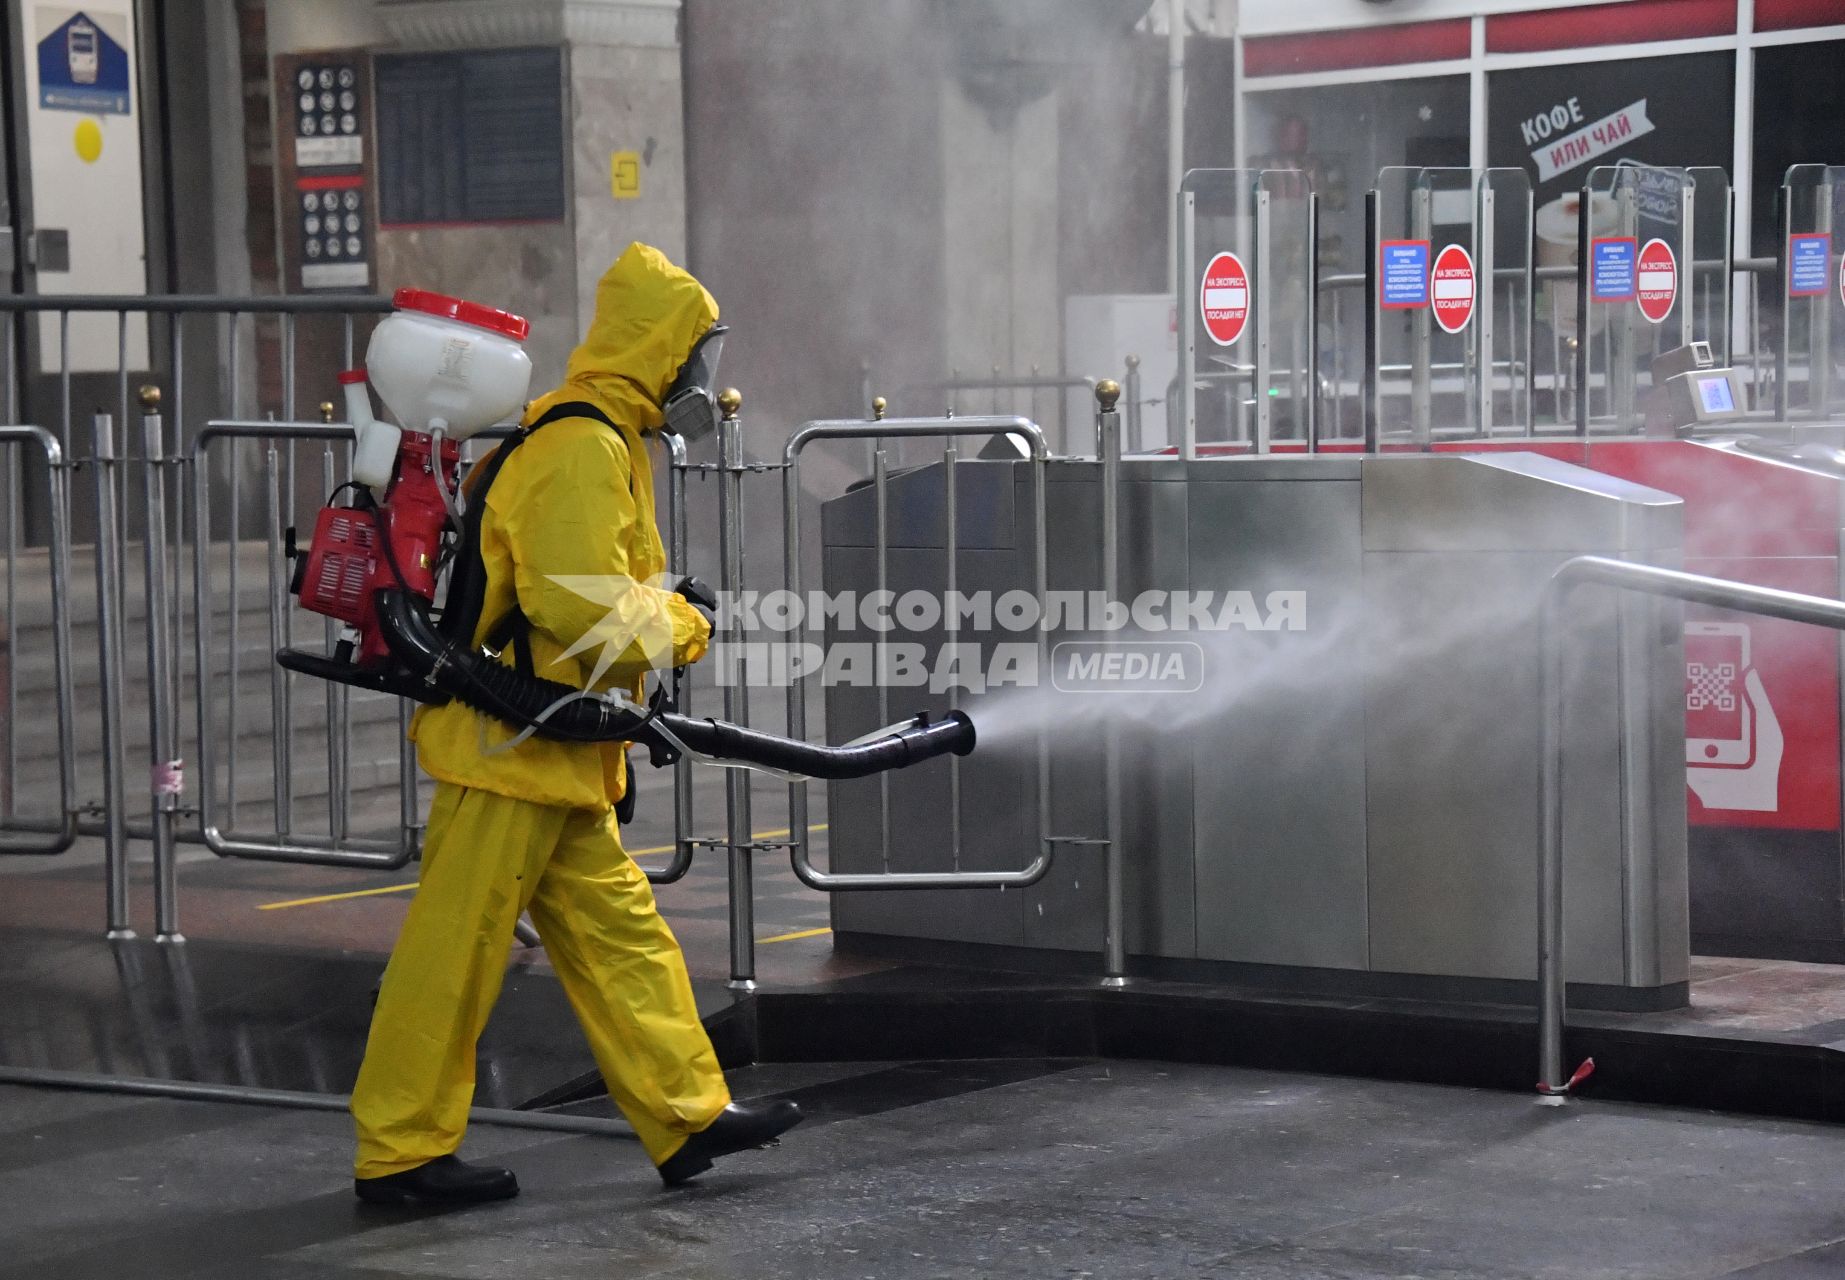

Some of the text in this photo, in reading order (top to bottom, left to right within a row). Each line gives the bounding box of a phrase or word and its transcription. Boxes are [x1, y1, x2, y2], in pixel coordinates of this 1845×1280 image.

[1521, 97, 1584, 146] КОФЕ
[1551, 113, 1632, 168] ИЛИ ЧАЙ
[1648, 261, 1672, 270] ЭКСПРЕСС
[1436, 268, 1471, 277] НА ЭКСПРЕСС
[1207, 277, 1245, 287] НА ЭКСПРЕСС
[1207, 310, 1244, 320] ПОСАДКИ НЕТ
